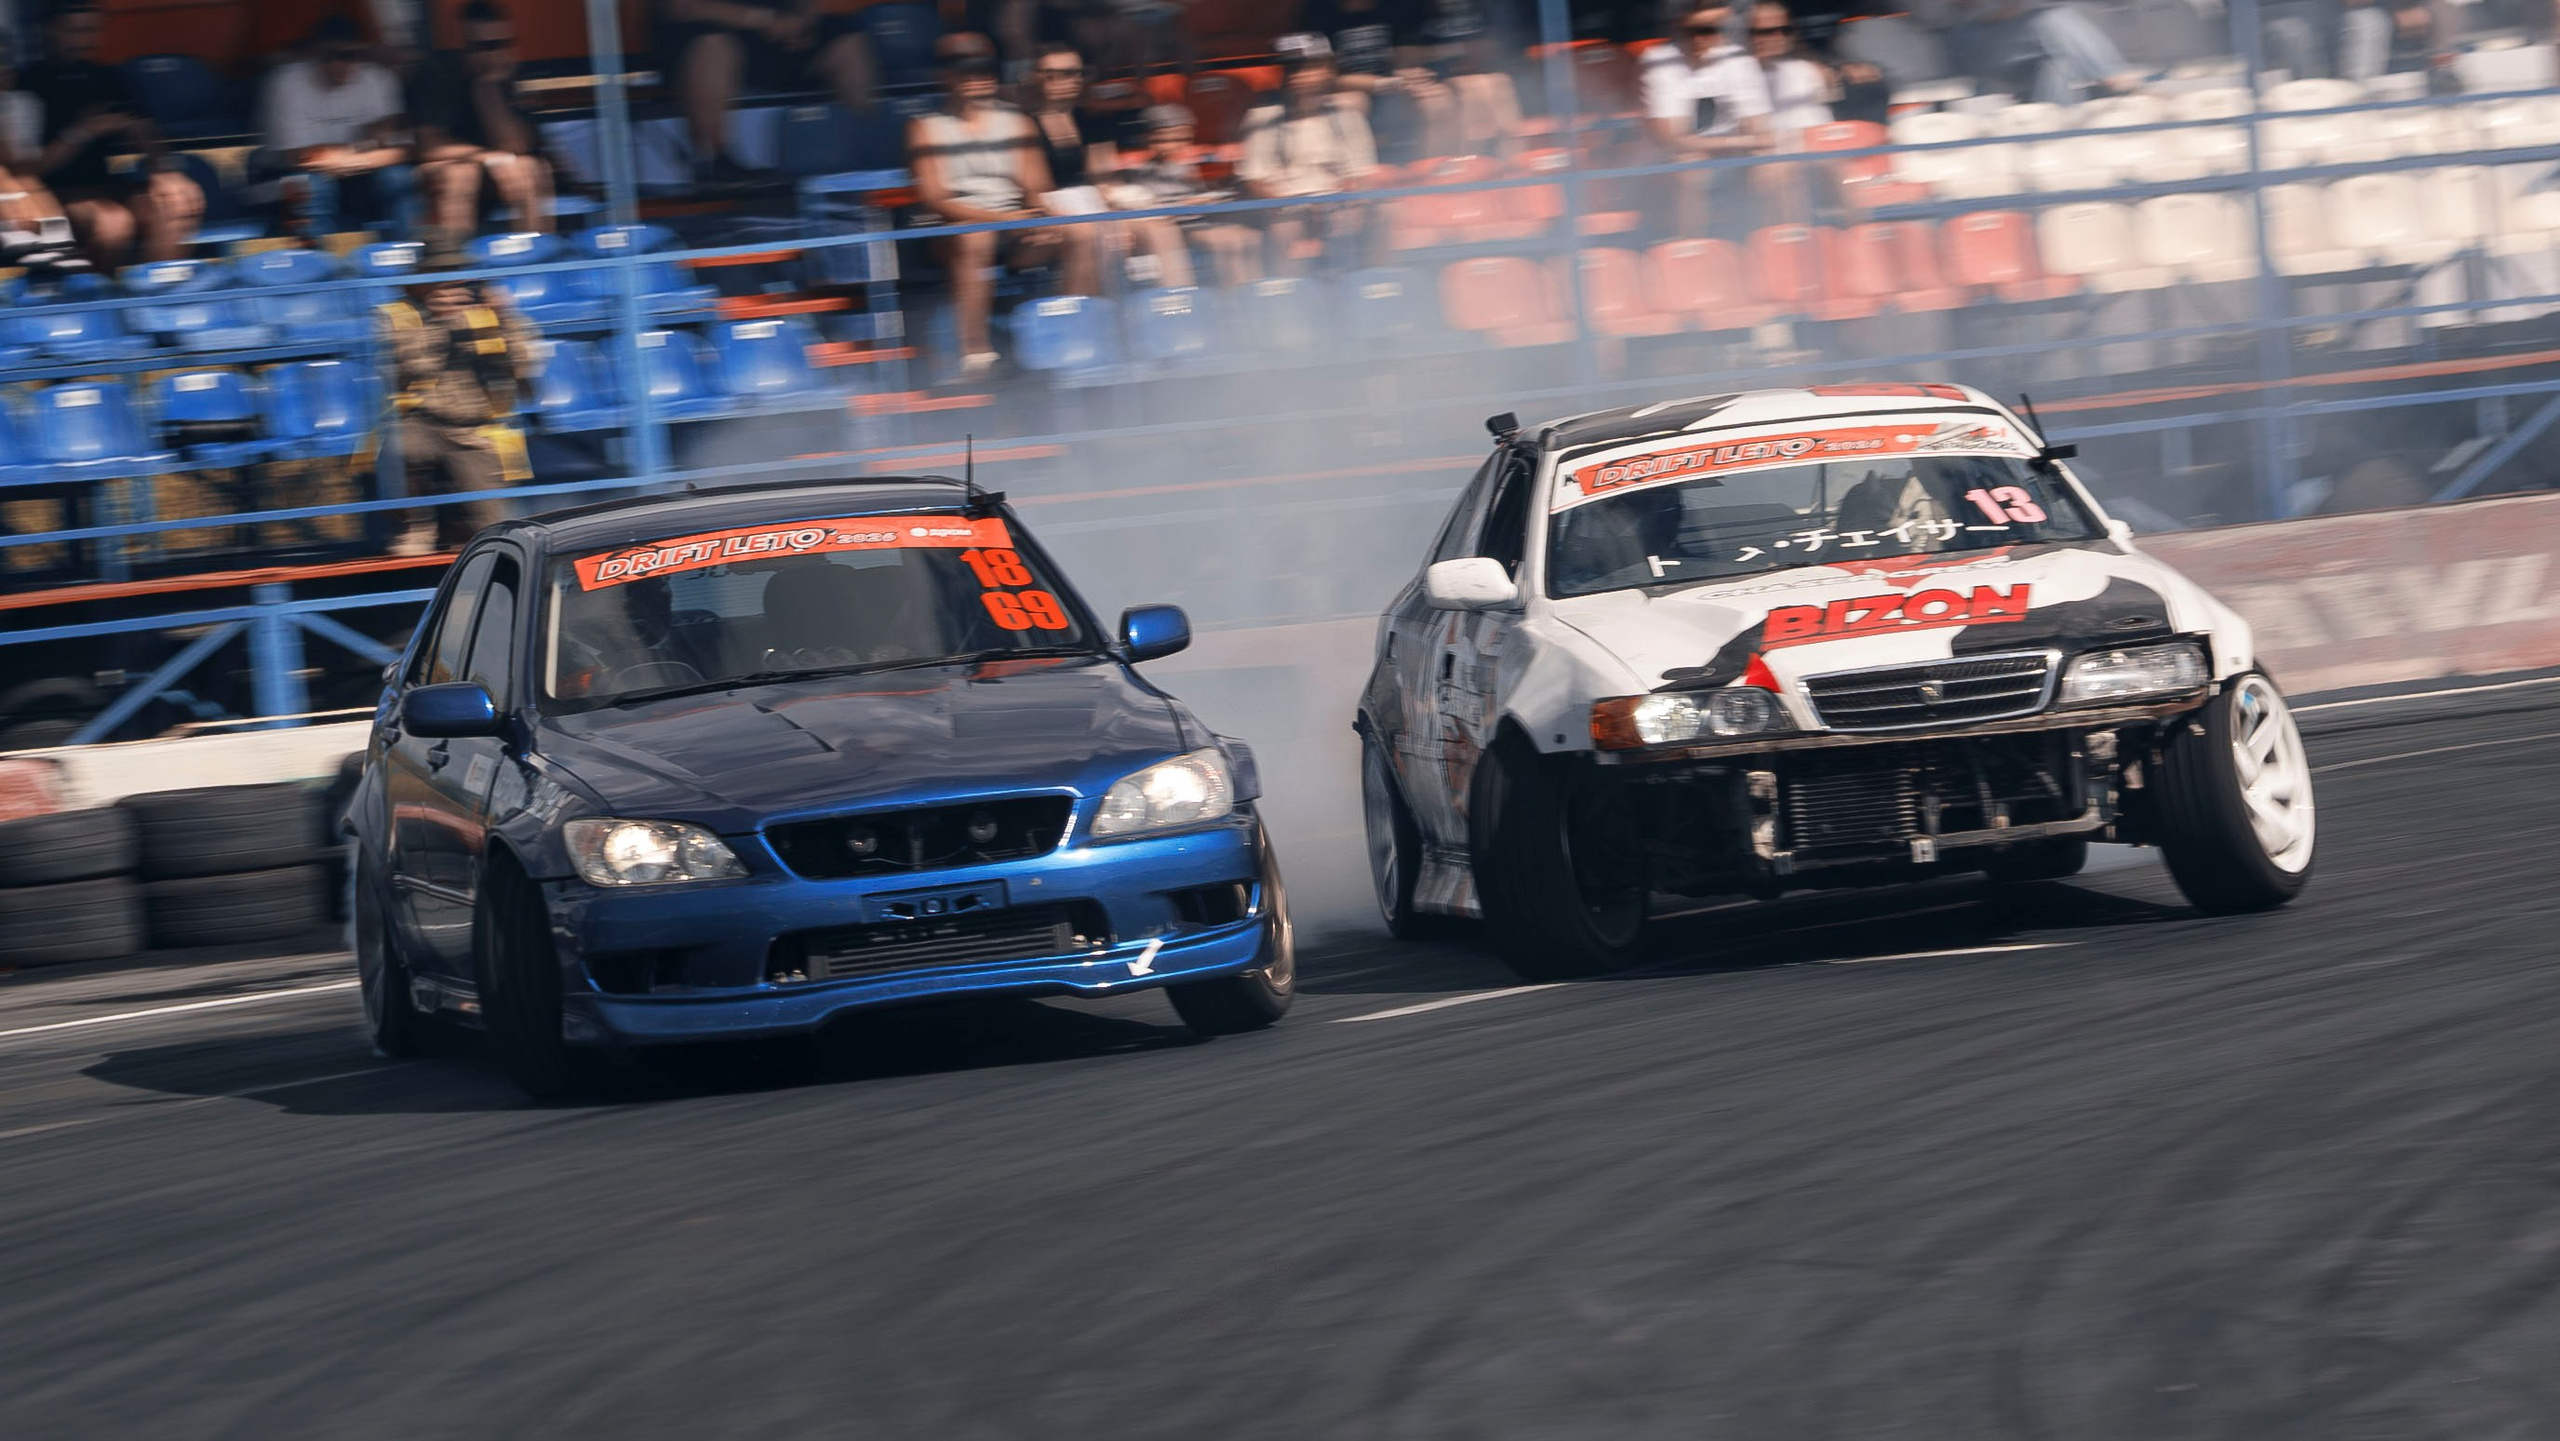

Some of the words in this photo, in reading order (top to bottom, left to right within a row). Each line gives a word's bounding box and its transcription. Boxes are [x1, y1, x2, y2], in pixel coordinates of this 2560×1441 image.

[1593, 450, 1714, 488] DRIFT
[1714, 437, 1817, 465] LETO
[1965, 485, 2047, 524] 13
[596, 540, 722, 582] DRIFT
[722, 528, 829, 557] LETO
[959, 549, 1033, 588] 18
[981, 589, 1070, 631] 69
[1763, 583, 2032, 644] BIZON
